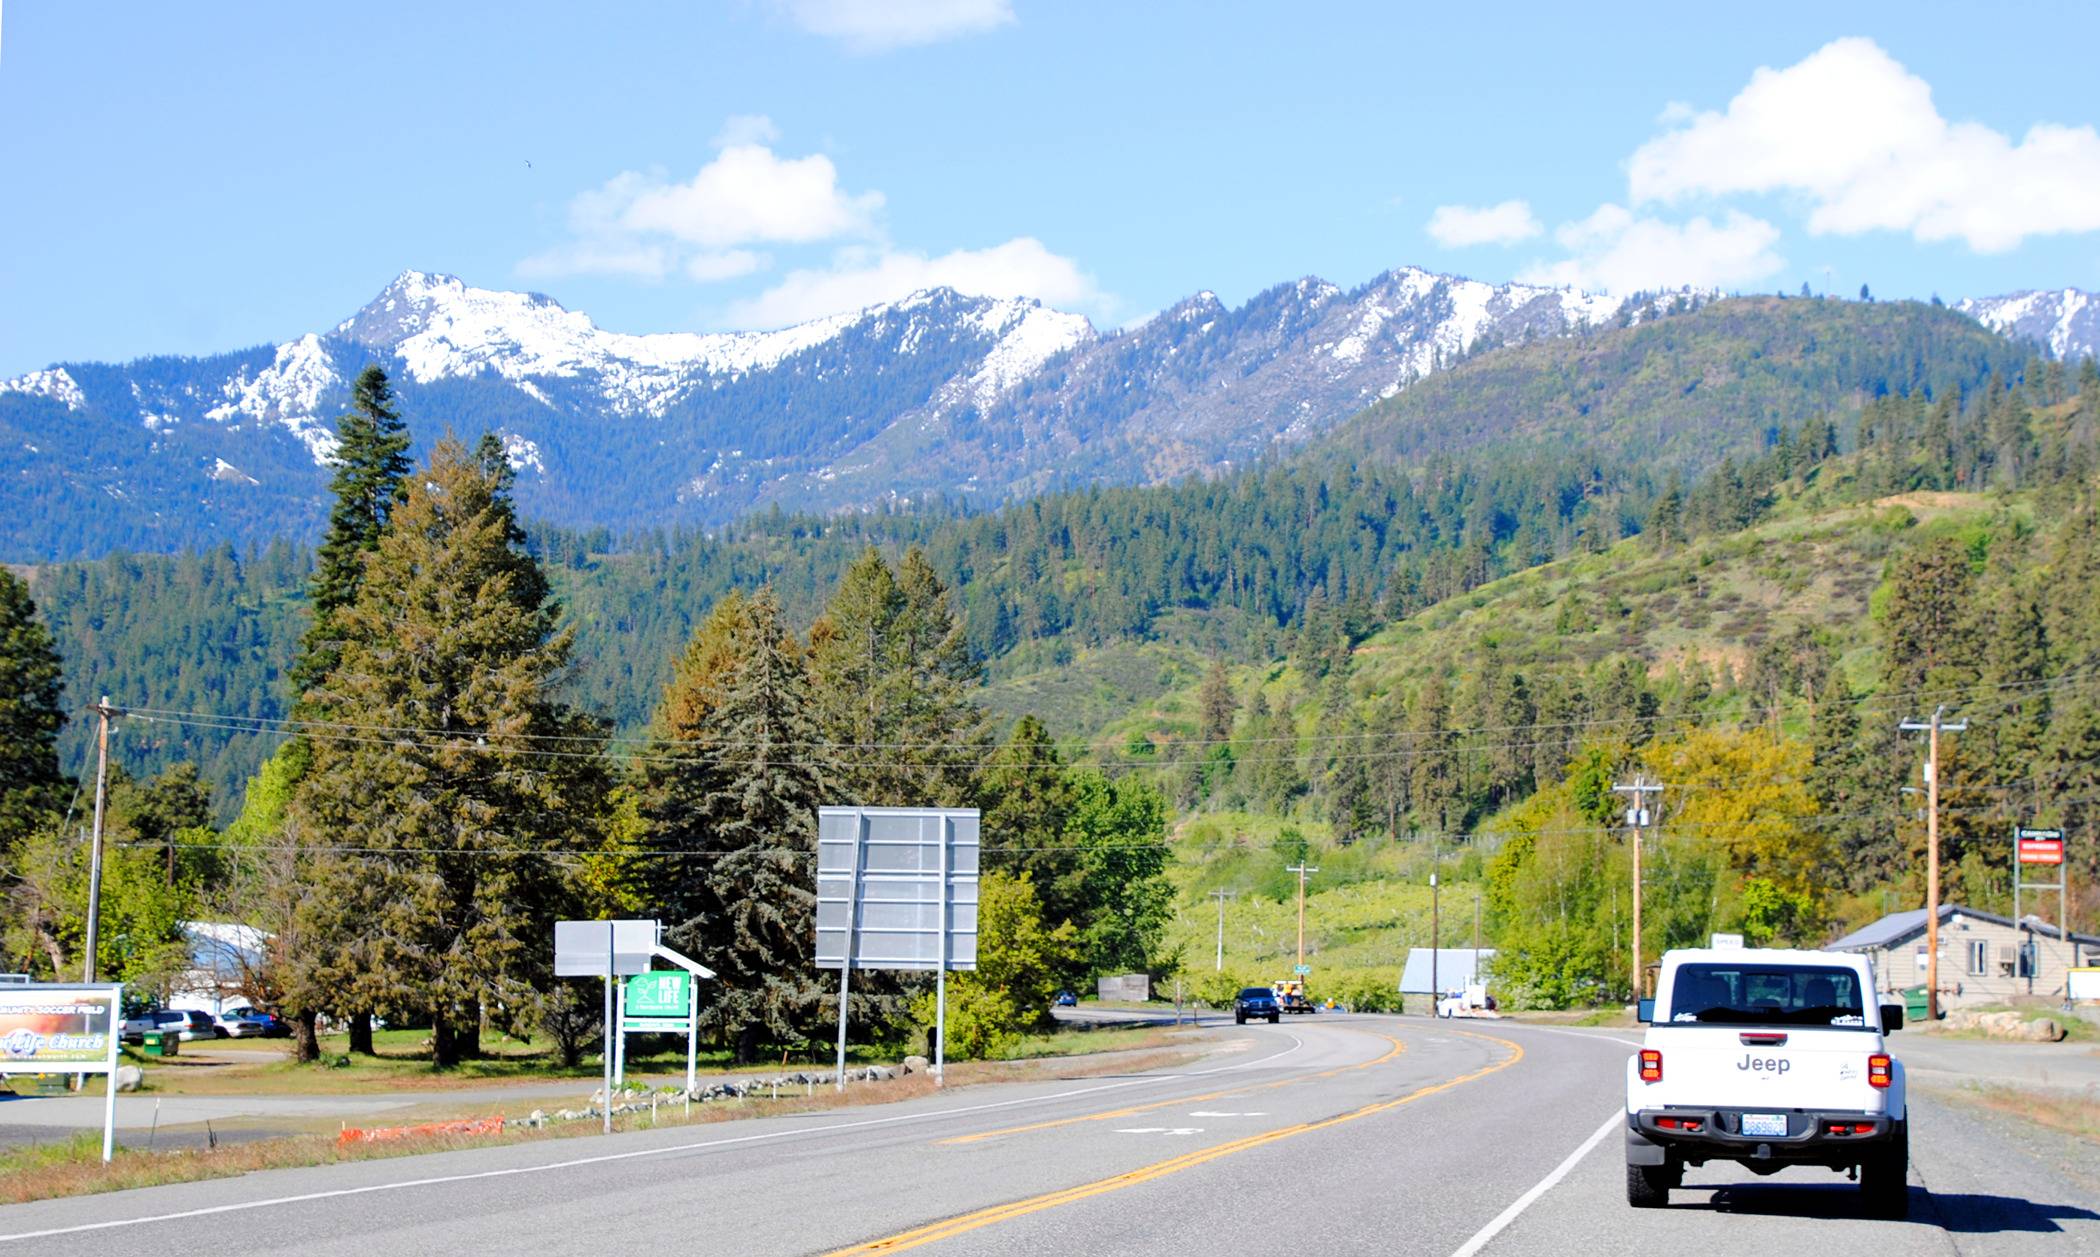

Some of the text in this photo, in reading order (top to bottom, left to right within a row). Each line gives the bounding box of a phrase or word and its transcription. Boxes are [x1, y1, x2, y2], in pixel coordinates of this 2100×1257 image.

[658, 976, 682, 989] NEW
[658, 990, 680, 1003] LIFE
[39, 1005, 76, 1015] SOCCER
[77, 1005, 105, 1014] FIELD
[49, 1032, 104, 1050] Church
[1737, 1054, 1790, 1075] Jeep
